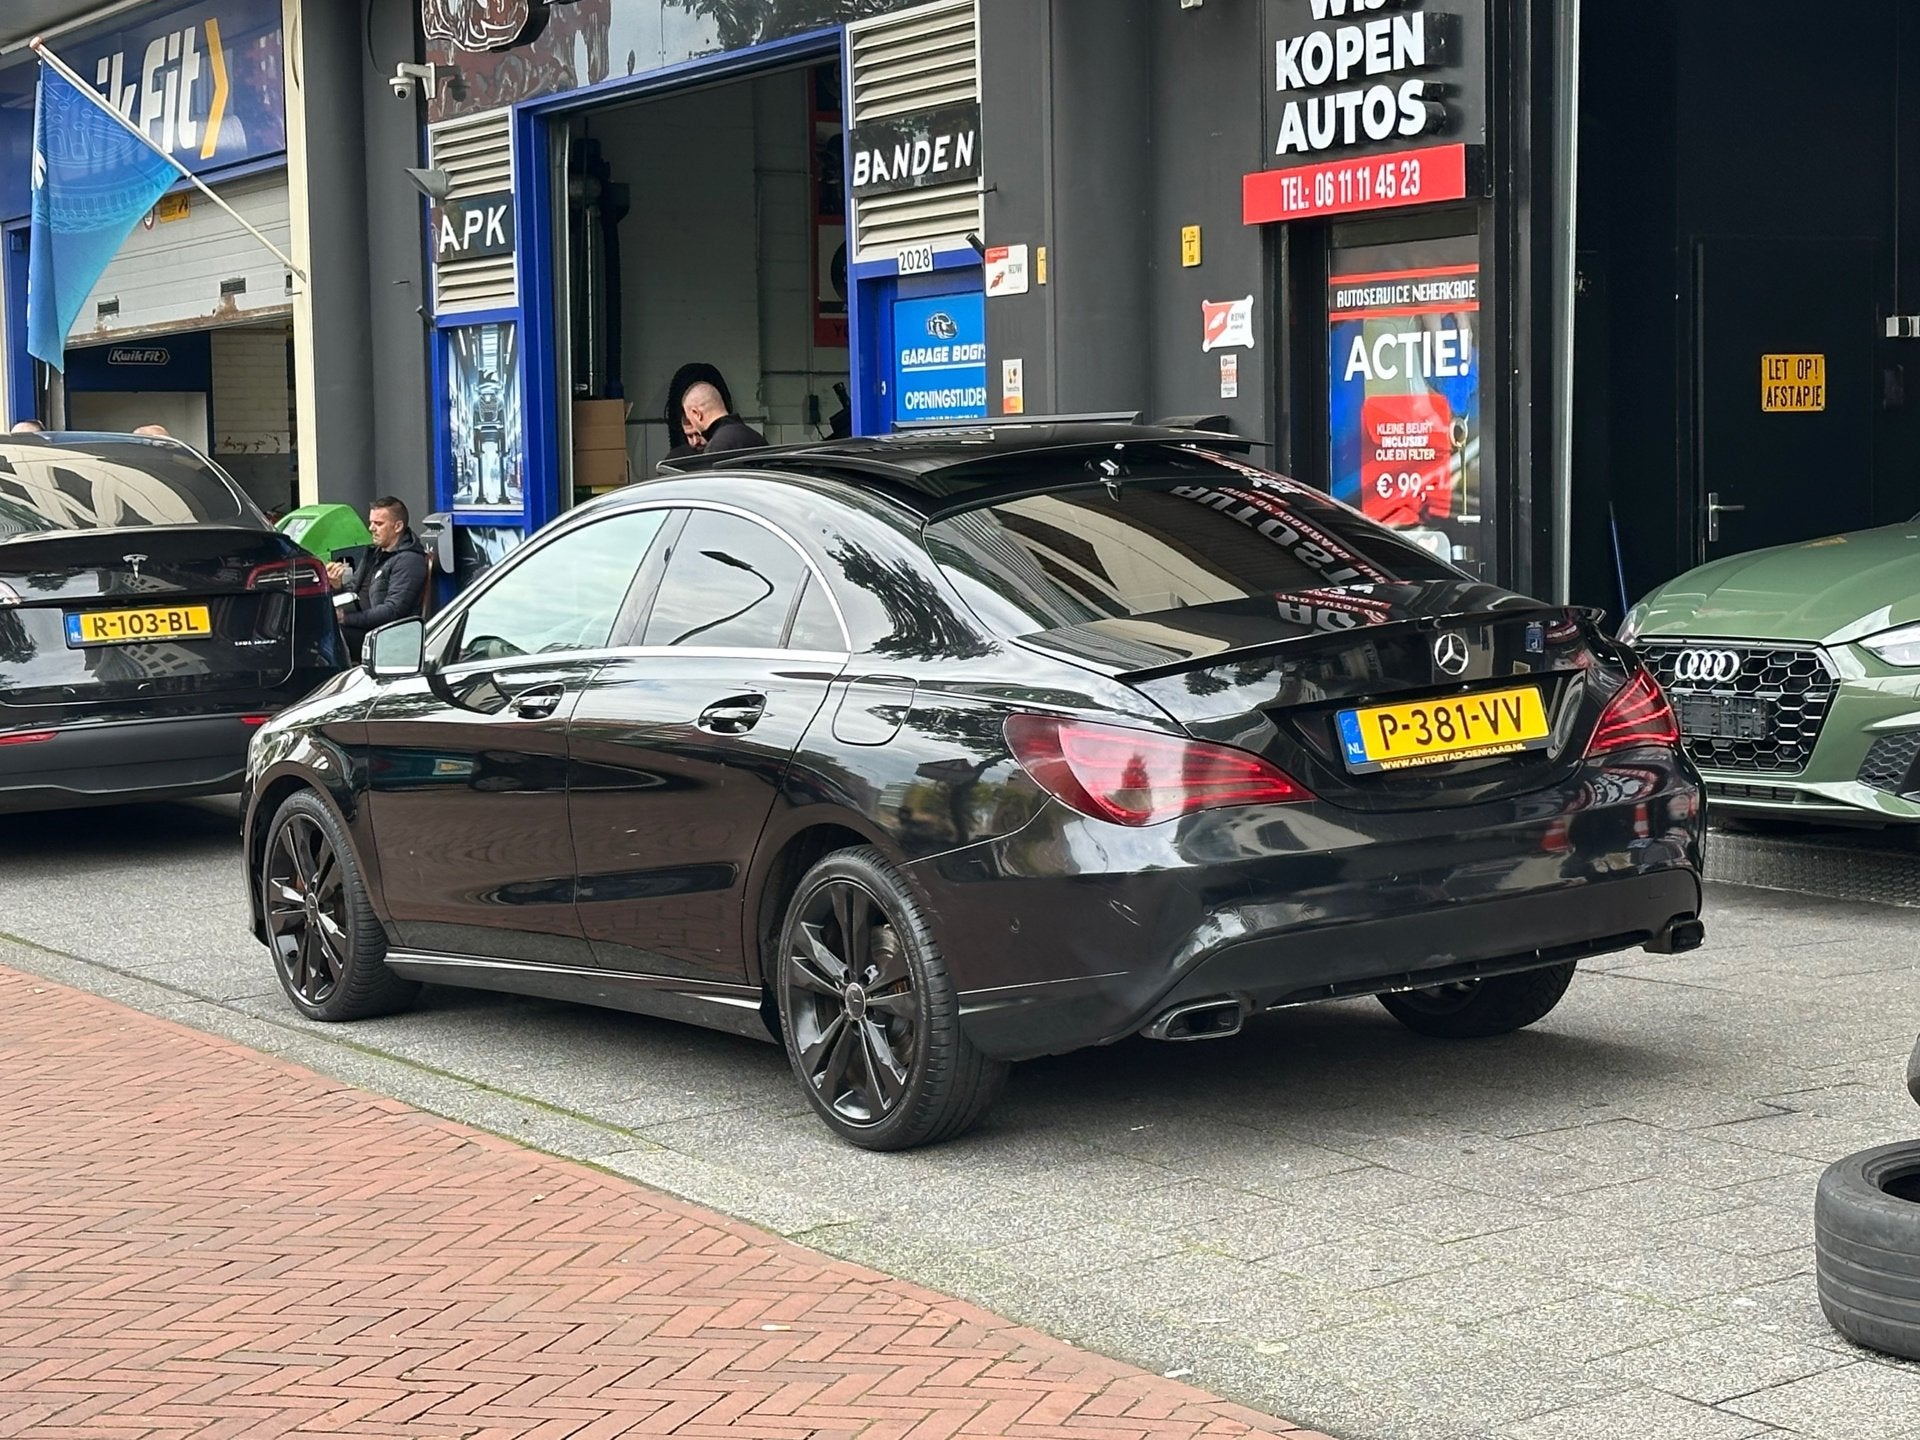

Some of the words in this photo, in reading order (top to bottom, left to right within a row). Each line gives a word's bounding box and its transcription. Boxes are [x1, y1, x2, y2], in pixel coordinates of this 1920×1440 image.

[1276, 11, 1425, 91] KOPEN
[1275, 79, 1427, 155] AUTOS
[852, 130, 975, 187] BANDEN
[1281, 176, 1310, 212] TEL:
[1315, 171, 1334, 208] 06
[1338, 168, 1352, 204] 11
[1356, 166, 1371, 202] 11
[1375, 163, 1396, 199] 45
[1401, 159, 1421, 197] 23
[439, 204, 507, 254] APK
[900, 248, 931, 272] 2028
[1412, 279, 1476, 303] NEHERKADE
[901, 345, 949, 366] GARAGE
[1344, 328, 1469, 382] ACTIE!
[1768, 358, 1789, 380] LET
[1766, 385, 1822, 408] AFSTAPJE
[1376, 422, 1405, 435] KLEINE
[1405, 421, 1433, 434] BEURT
[1375, 449, 1395, 461] OLIE
[1396, 448, 1407, 460] EN
[1408, 447, 1436, 461] FILTER
[1381, 435, 1429, 448] INCLUSIEF
[92, 611, 199, 638] R-103-BL
[1348, 742, 1364, 756] NL
[1377, 696, 1521, 751] P-381-VV
